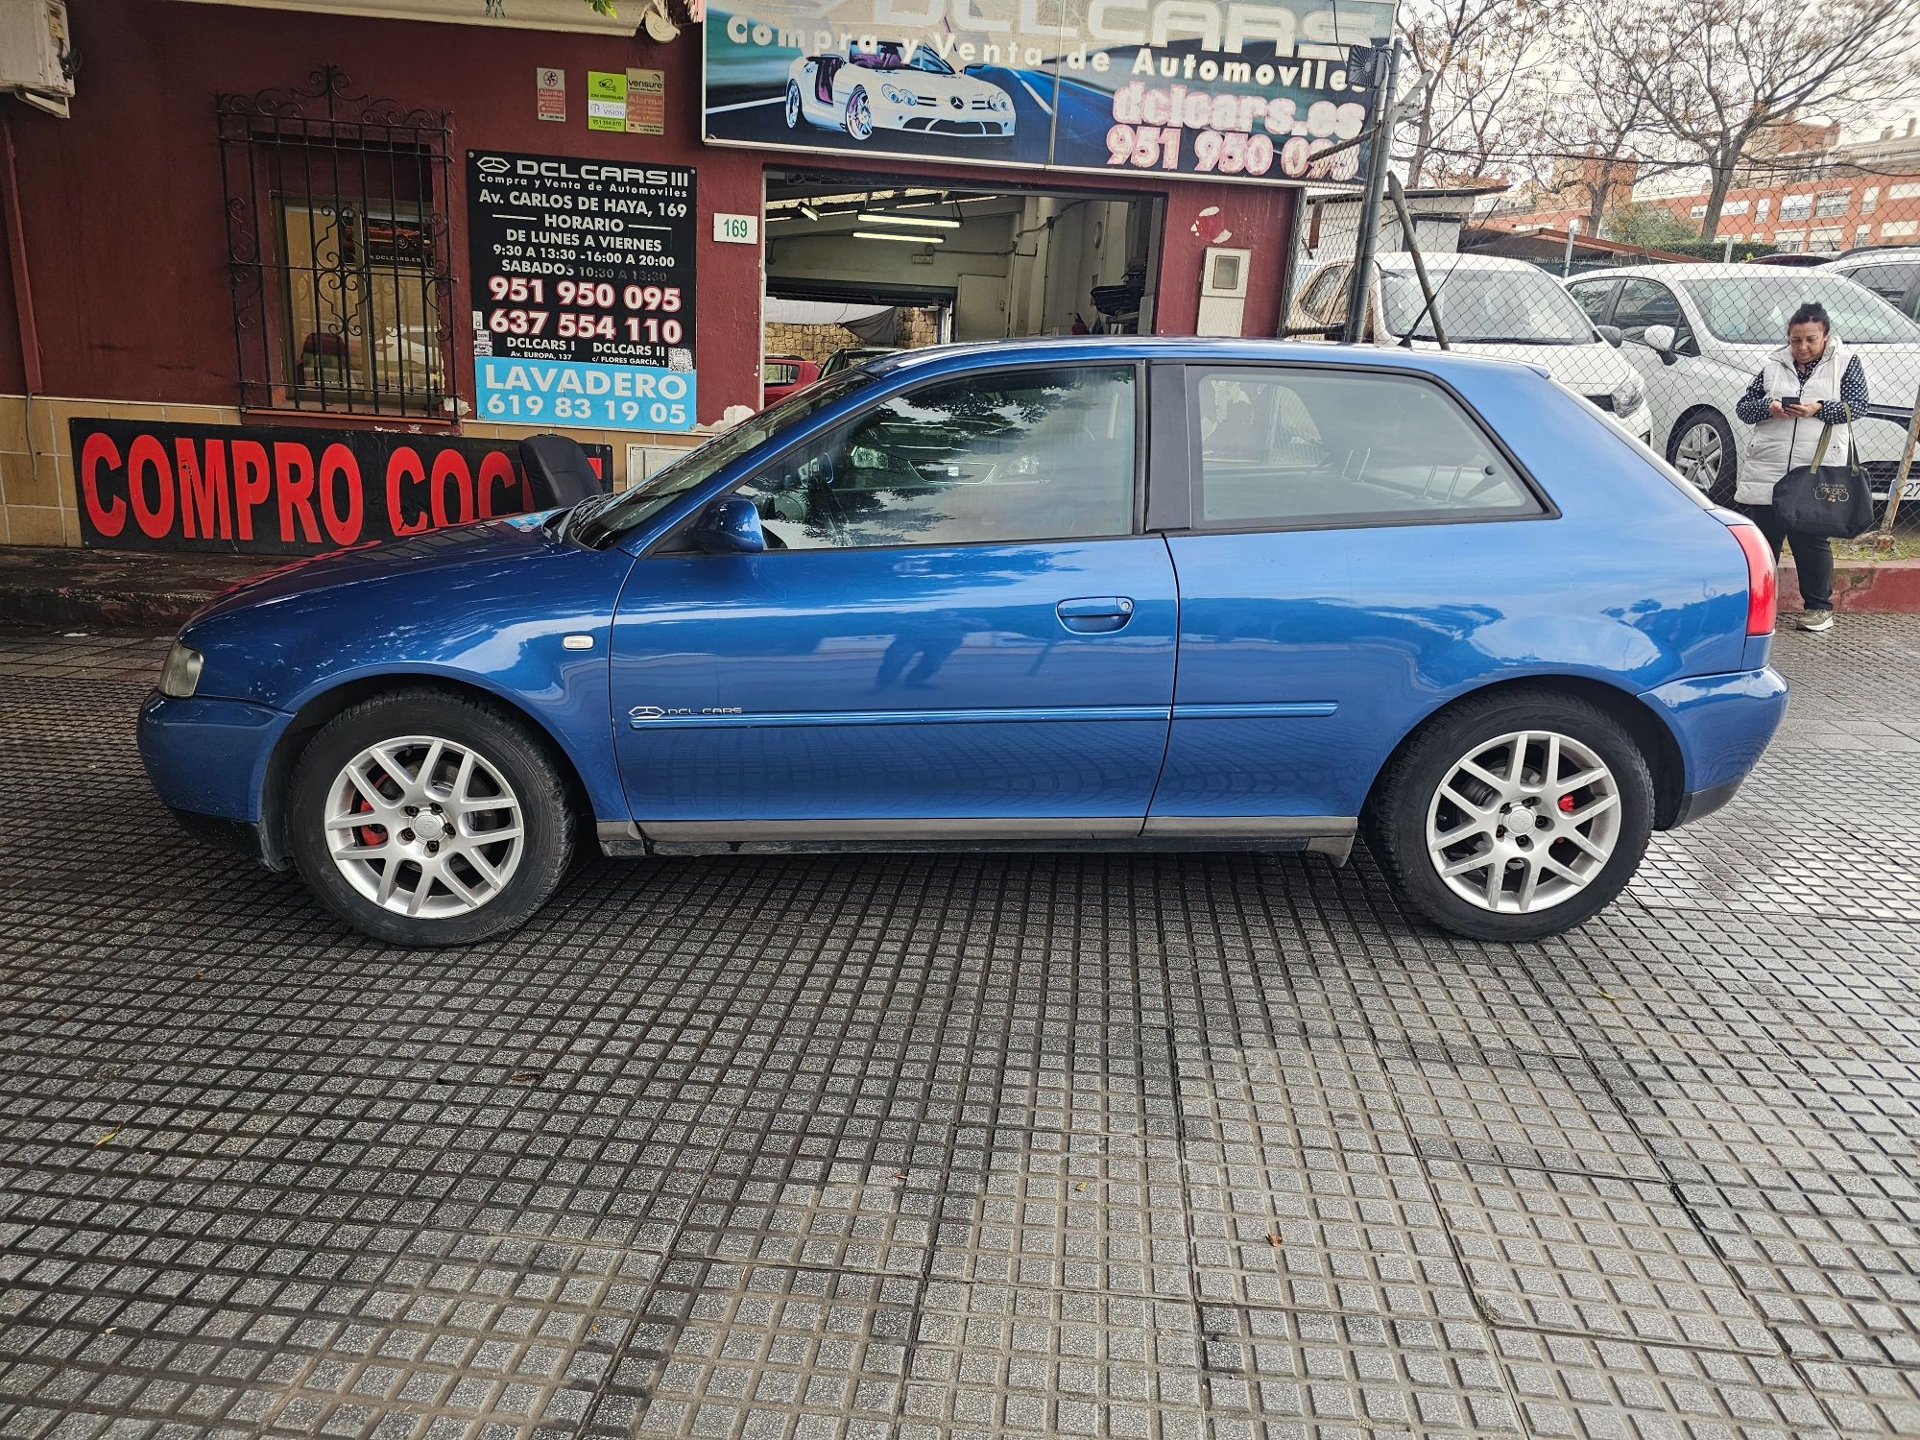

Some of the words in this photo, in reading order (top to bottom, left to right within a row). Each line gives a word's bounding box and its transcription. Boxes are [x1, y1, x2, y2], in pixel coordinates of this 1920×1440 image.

[726, 13, 880, 55] Compra
[902, 37, 920, 64] y
[931, 34, 1043, 67] Venta
[1067, 42, 1111, 72] de
[1132, 48, 1366, 92] Automovile
[1112, 81, 1366, 140] dclcars.es
[1106, 124, 1181, 170] 951
[1194, 130, 1273, 176] 950
[478, 173, 528, 186] Compra
[534, 179, 541, 188] y
[544, 179, 581, 190] Venta
[587, 181, 603, 192] de
[609, 183, 688, 198] Automoviles
[516, 160, 668, 185] DCLCARS
[671, 172, 689, 187] III
[478, 189, 504, 204] Av.
[509, 191, 573, 210] CARLOS
[578, 196, 599, 211] DE
[604, 199, 653, 218] HAYA,
[658, 202, 688, 218] 169
[544, 213, 624, 232] HORARIO
[724, 218, 748, 238] 169
[506, 229, 527, 243] DE
[531, 231, 580, 247] LUNES
[583, 234, 596, 248] A
[599, 235, 663, 252] VIERNES
[492, 243, 522, 256] 9:30
[525, 246, 536, 258] A
[540, 248, 576, 260] 13:30
[625, 253, 636, 265] A
[638, 255, 675, 268] 20:00
[501, 259, 575, 276] SABADOS
[488, 274, 545, 304] 951
[556, 280, 616, 309] 950
[623, 284, 682, 313] 095
[489, 308, 550, 336] 637
[557, 312, 617, 341] 554
[624, 316, 683, 345] 110
[506, 337, 567, 351] DCLCARS
[510, 350, 522, 358] Av.
[524, 351, 557, 361] EUROPA,
[559, 353, 572, 361] 137
[592, 342, 652, 356] DCLCARS
[601, 356, 628, 365] FLORES
[485, 364, 688, 400] LAVADERO
[487, 393, 544, 416] 619
[554, 397, 592, 420] 83
[604, 400, 640, 422] 19
[650, 402, 686, 425] 05
[81, 432, 363, 546] COMPRO
[702, 707, 742, 715] CARS
